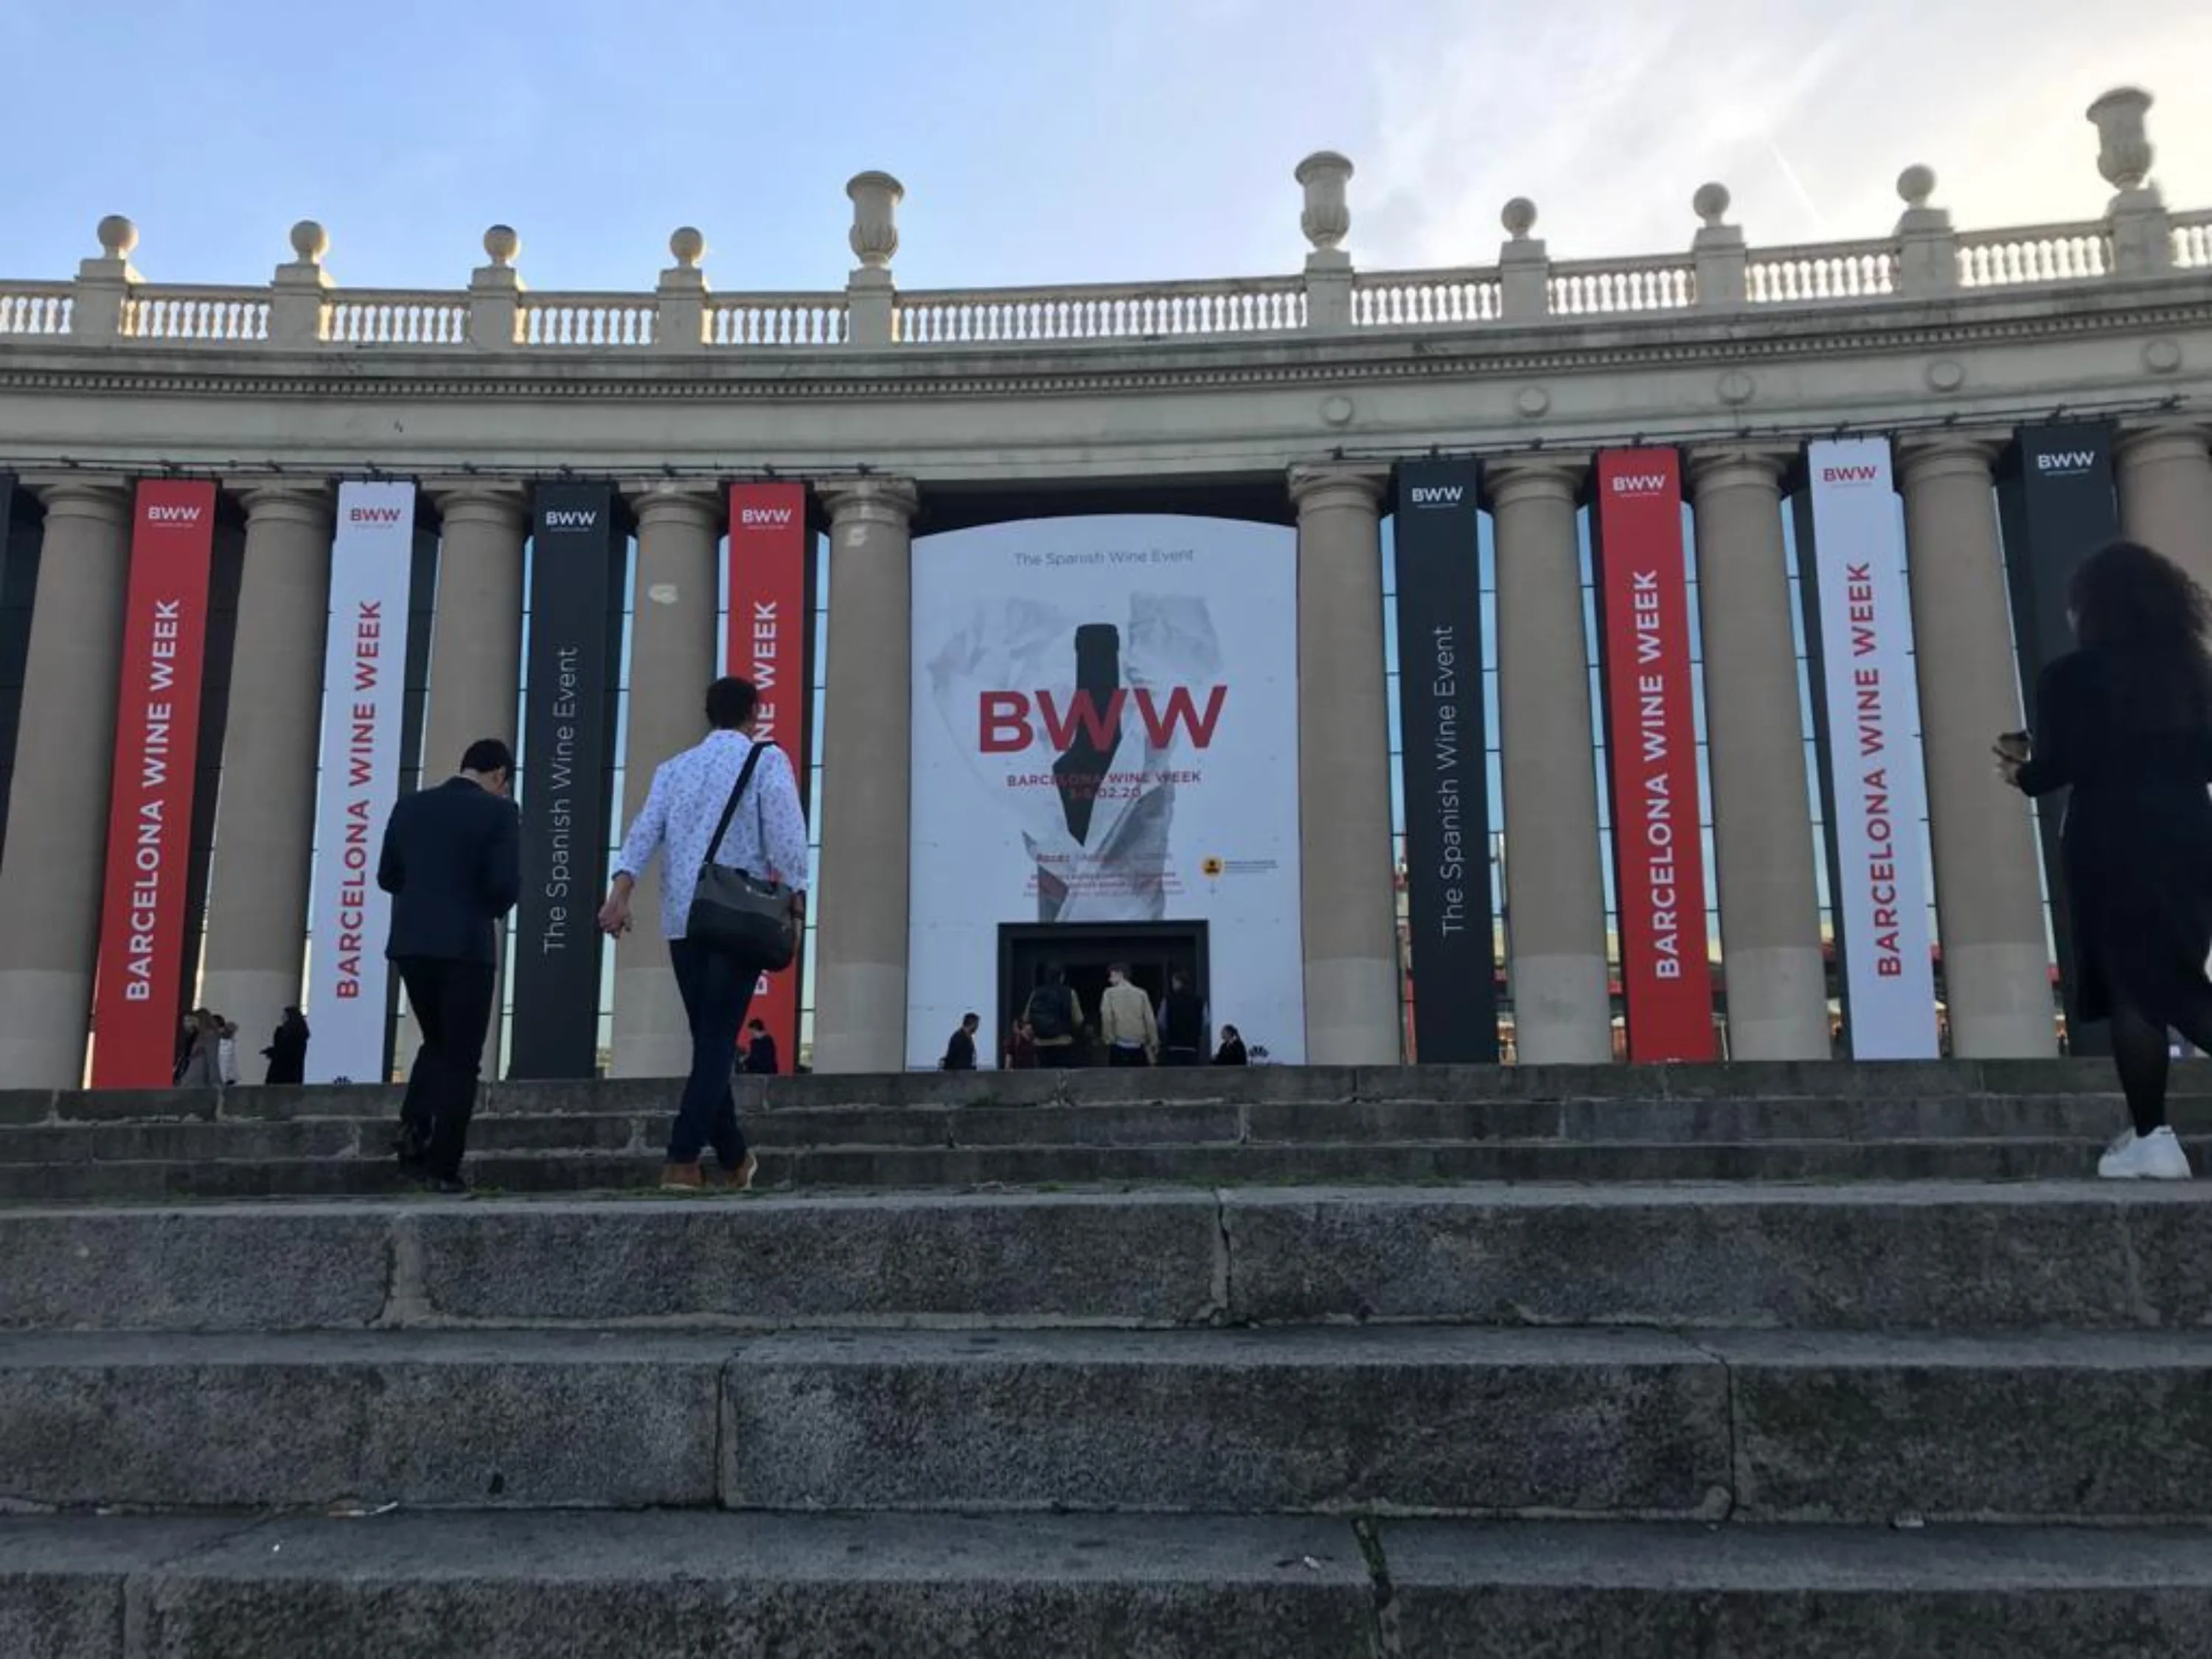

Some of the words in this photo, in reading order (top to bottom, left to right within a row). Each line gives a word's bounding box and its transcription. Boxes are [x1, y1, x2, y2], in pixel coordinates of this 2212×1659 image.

[1412, 487, 1463, 502] BWW
[1613, 476, 1666, 491] BWW
[1823, 467, 1877, 482] BWW
[2037, 451, 2096, 469] BWW
[148, 507, 201, 520] BWW
[350, 508, 400, 521] BWW
[546, 511, 597, 524] BWW
[742, 509, 791, 523] BWW
[1015, 552, 1043, 565] The
[1046, 552, 1105, 566] Spanish
[1108, 552, 1147, 563] Wine
[1151, 549, 1193, 562] Event
[150, 599, 179, 689] WEEK
[1633, 571, 1662, 663] WEEK
[1848, 563, 1877, 657] WEEK
[355, 601, 381, 689] WEEK
[754, 601, 779, 689] WEEK
[1434, 627, 1455, 695] Event
[554, 647, 578, 717] Event
[1854, 669, 1884, 756] WINE
[142, 703, 172, 786] WINE
[349, 703, 375, 785] WINE
[752, 702, 776, 742] NE
[979, 684, 1228, 753] BWW
[1435, 704, 1457, 768] Wine
[1638, 675, 1666, 761] WINE
[552, 725, 574, 790] Wine
[1108, 772, 1150, 785] WINE
[1155, 771, 1201, 784] WEEK
[547, 796, 570, 897] Spanish
[1437, 779, 1465, 879] Spanish
[126, 800, 164, 1001] BARCELONA
[337, 799, 370, 998] BARCELONA
[1646, 773, 1680, 979] BARCELONA
[1864, 768, 1902, 977] BARCELONA
[543, 906, 567, 952] The
[1442, 888, 1463, 936] The
